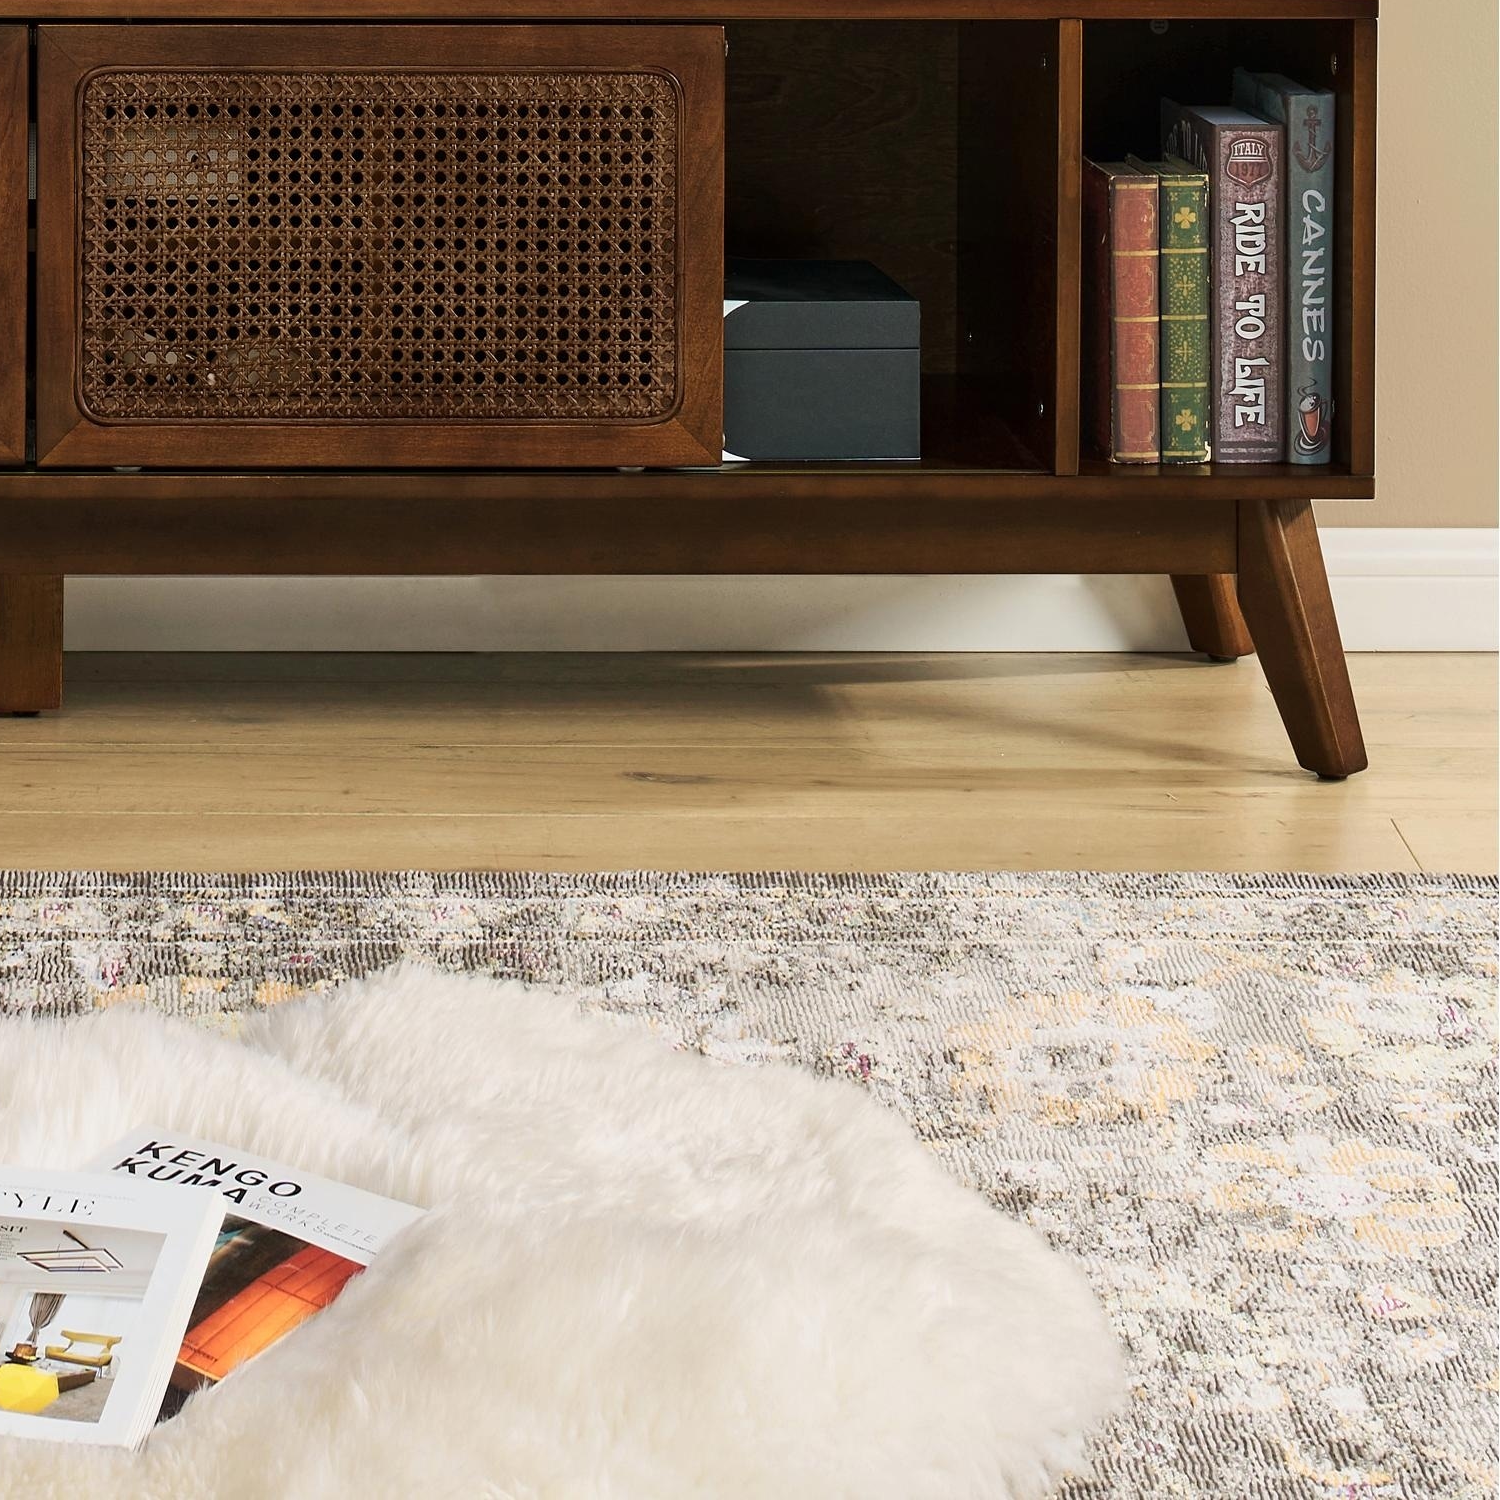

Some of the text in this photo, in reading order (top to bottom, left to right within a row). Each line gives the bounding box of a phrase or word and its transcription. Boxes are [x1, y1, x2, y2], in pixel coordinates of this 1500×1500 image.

[1233, 142, 1264, 156] ITALY
[1302, 189, 1326, 362] CANNES
[1228, 202, 1270, 428] RIDE TO LIFE
[112, 1157, 248, 1205] KUMA
[136, 1140, 302, 1197] KENGO
[248, 1201, 326, 1234] WORKS
[258, 1195, 378, 1244] COMPLETE
